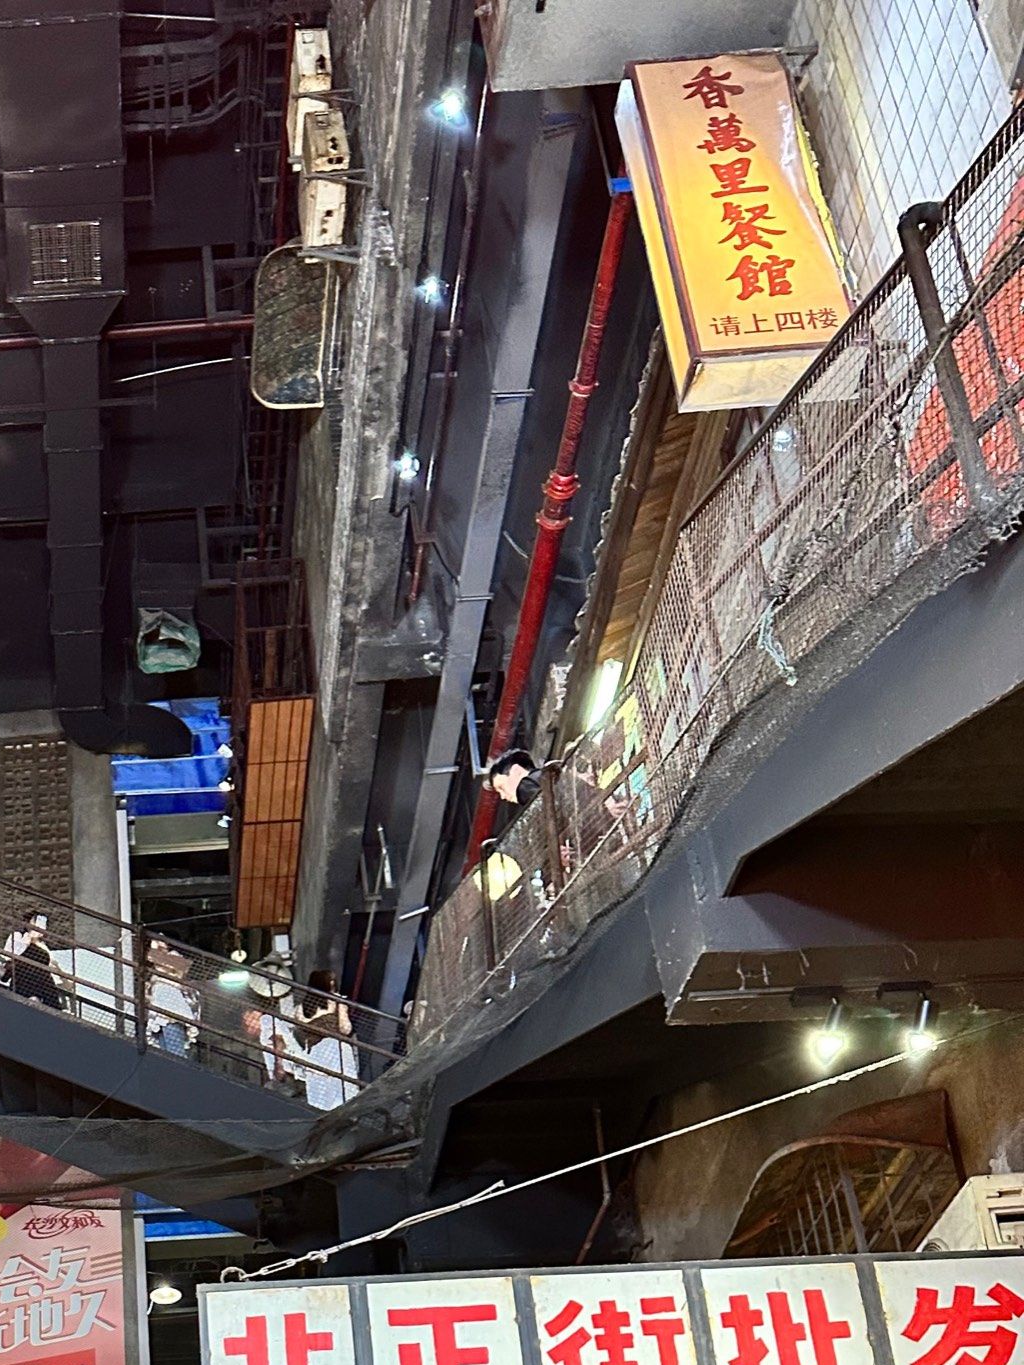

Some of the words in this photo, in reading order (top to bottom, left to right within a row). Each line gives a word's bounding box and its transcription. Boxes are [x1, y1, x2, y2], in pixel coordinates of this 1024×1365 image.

[682, 66, 795, 301] 香萬里餐館
[709, 307, 839, 337] 请上四楼
